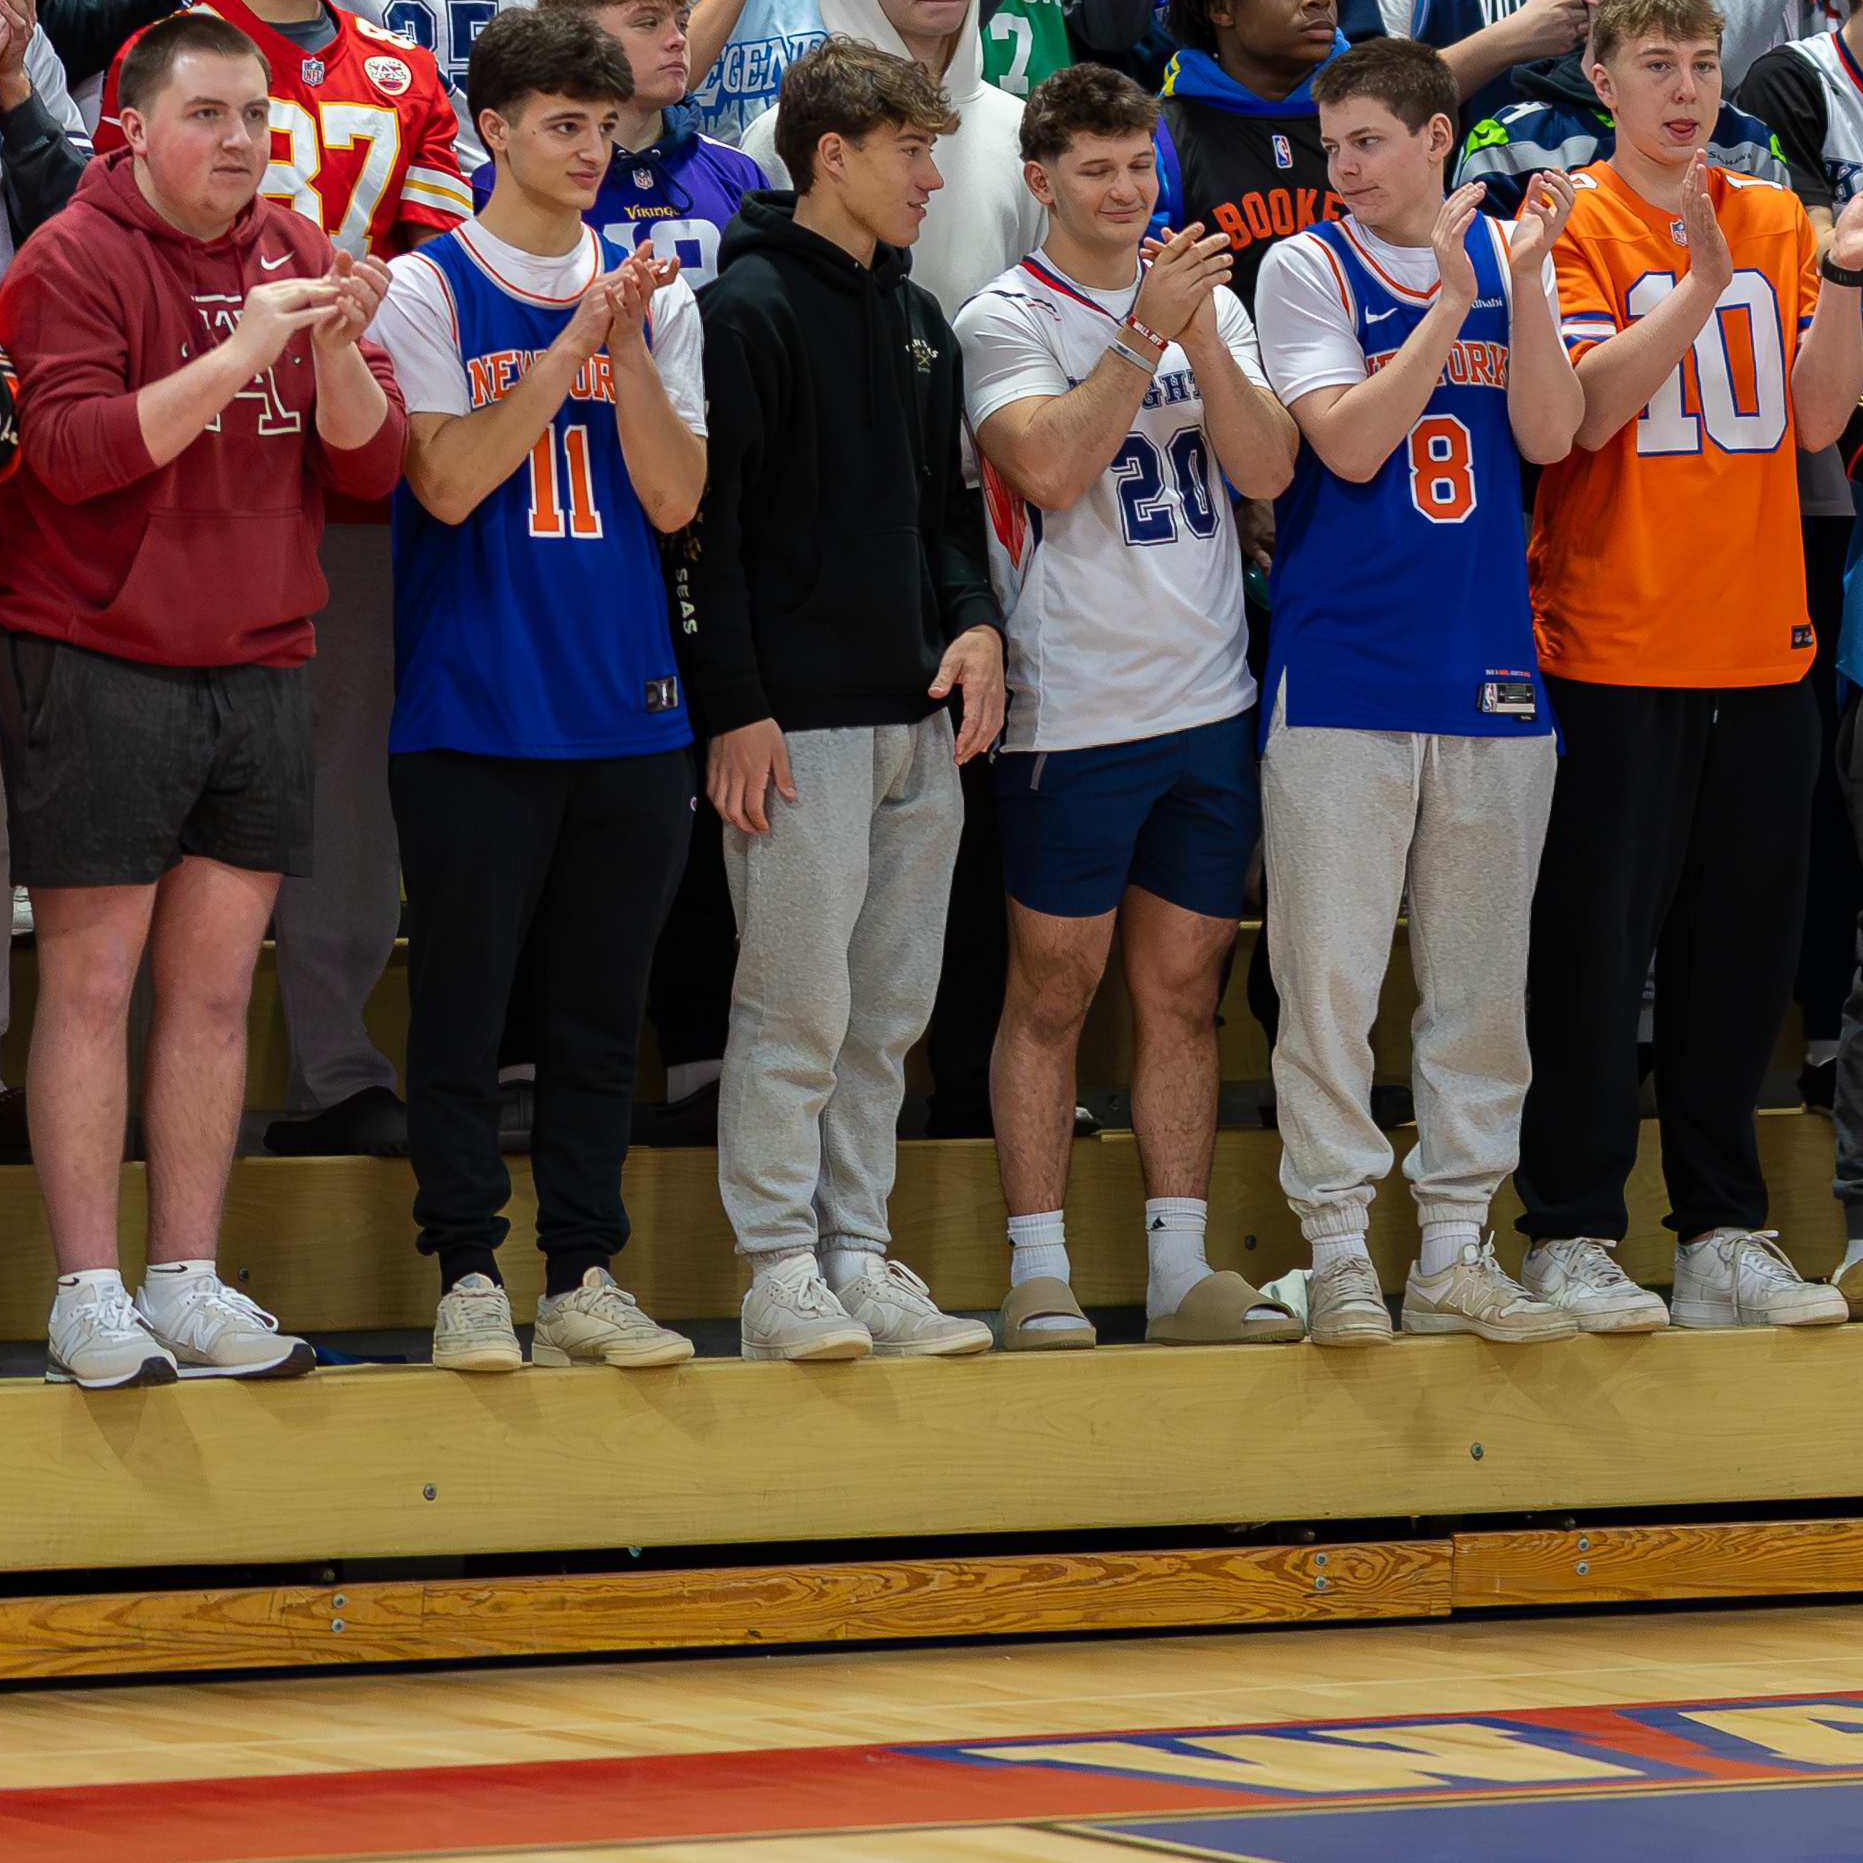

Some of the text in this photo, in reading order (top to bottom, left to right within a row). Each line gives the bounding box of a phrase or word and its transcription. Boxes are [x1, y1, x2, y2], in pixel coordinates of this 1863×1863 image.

[1625, 267, 1787, 460] 10
[528, 423, 603, 539] 11
[1109, 425, 1221, 547] 20
[1407, 413, 1477, 524] 8
[676, 567, 699, 635] SEAS
